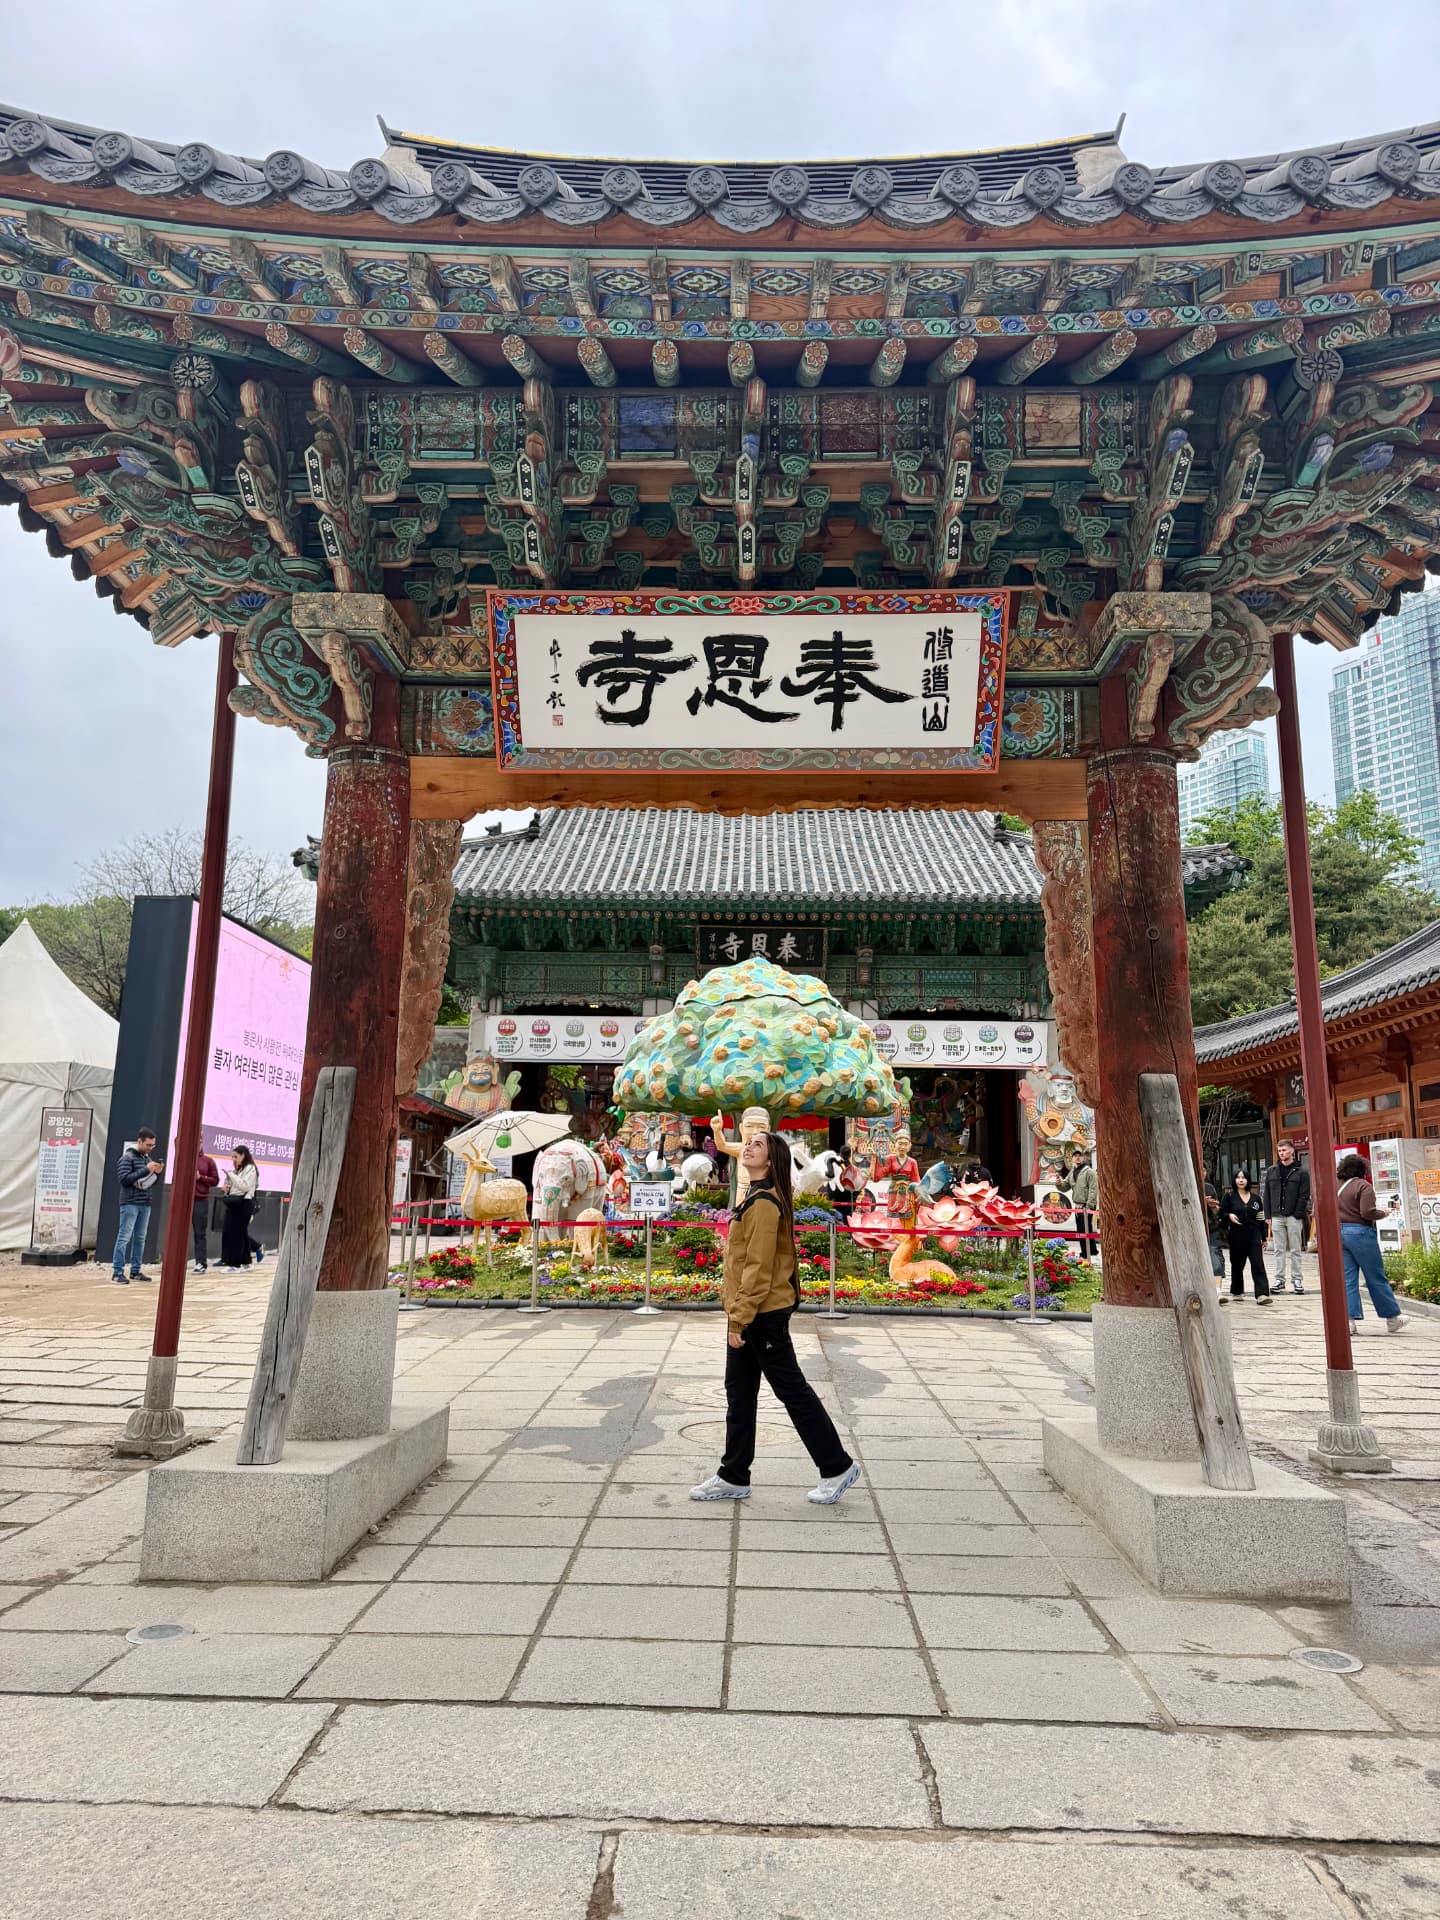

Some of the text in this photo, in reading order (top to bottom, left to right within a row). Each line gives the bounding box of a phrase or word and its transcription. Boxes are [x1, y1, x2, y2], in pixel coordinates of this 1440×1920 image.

[575, 628, 919, 732] 奉恩寺
[214, 1048, 232, 1072] 불자
[234, 1054, 267, 1082] 여러분의
[268, 1065, 284, 1087] 많은
[55, 1127, 73, 1137] 운영
